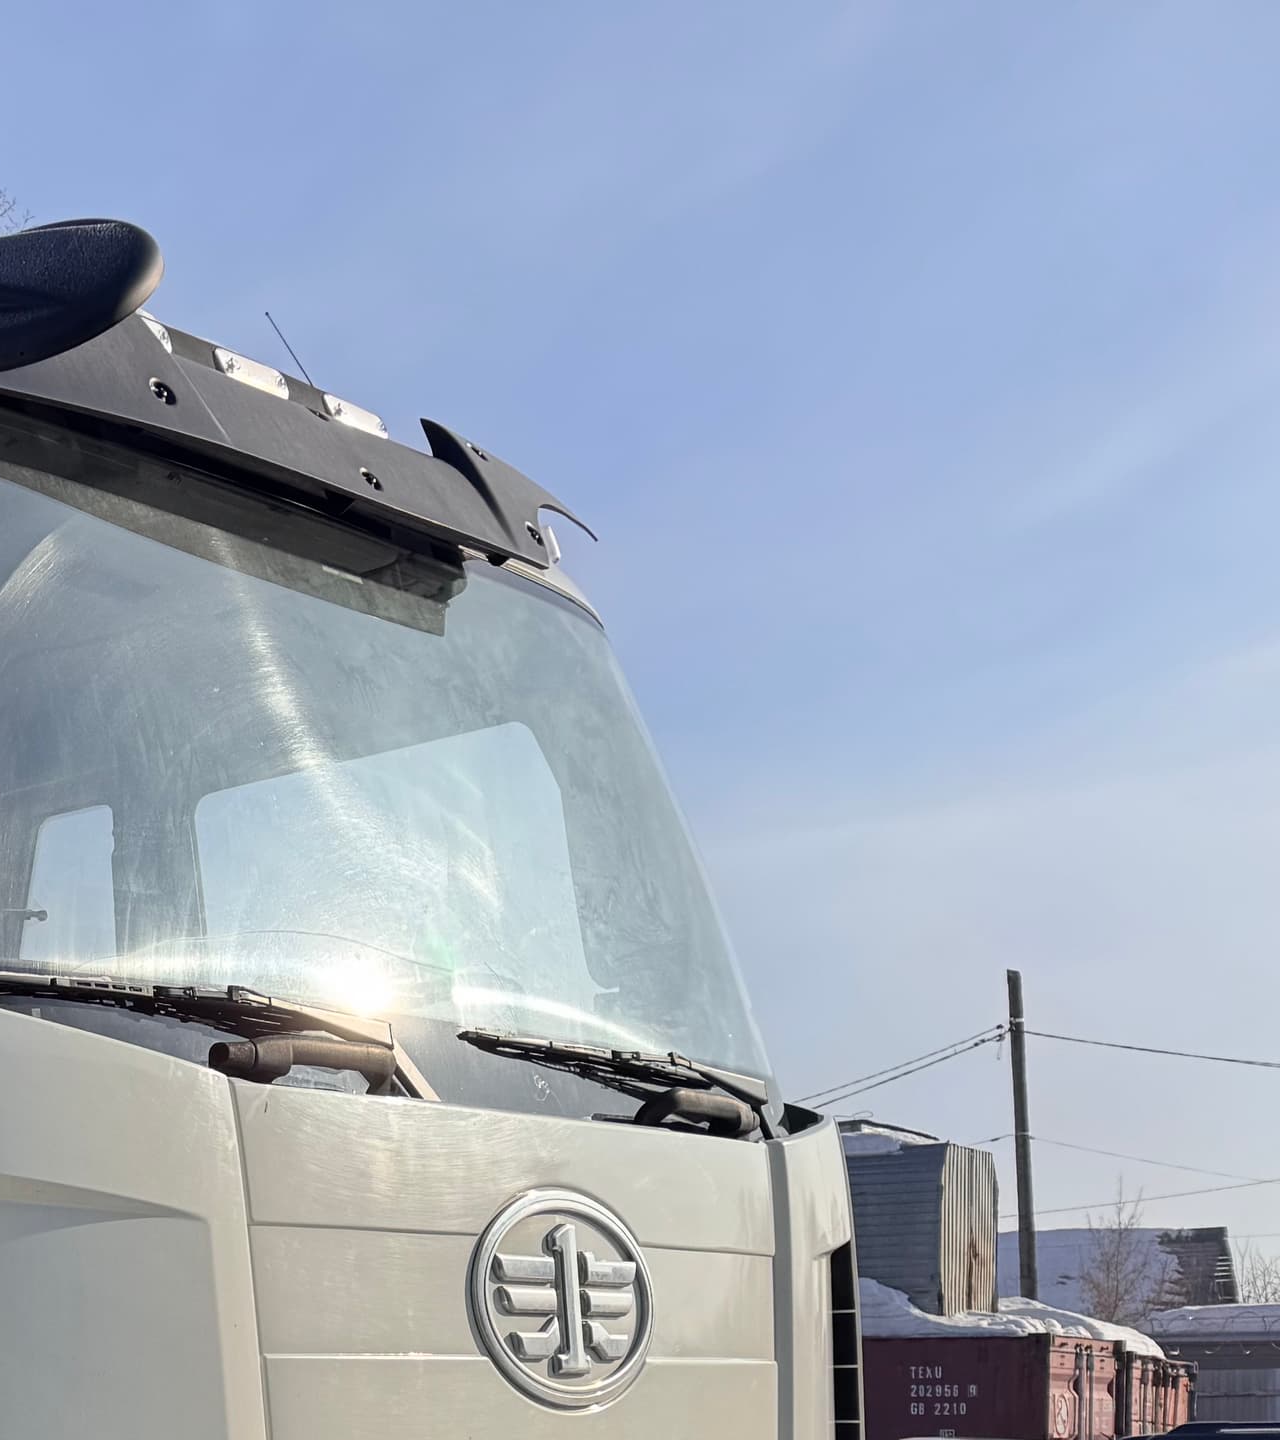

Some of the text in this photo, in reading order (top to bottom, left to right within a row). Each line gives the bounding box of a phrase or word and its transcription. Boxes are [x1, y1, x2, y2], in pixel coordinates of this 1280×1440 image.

[909, 1366, 942, 1379] TEXU
[910, 1384, 959, 1397] 202956
[934, 1402, 967, 1415] 2210
